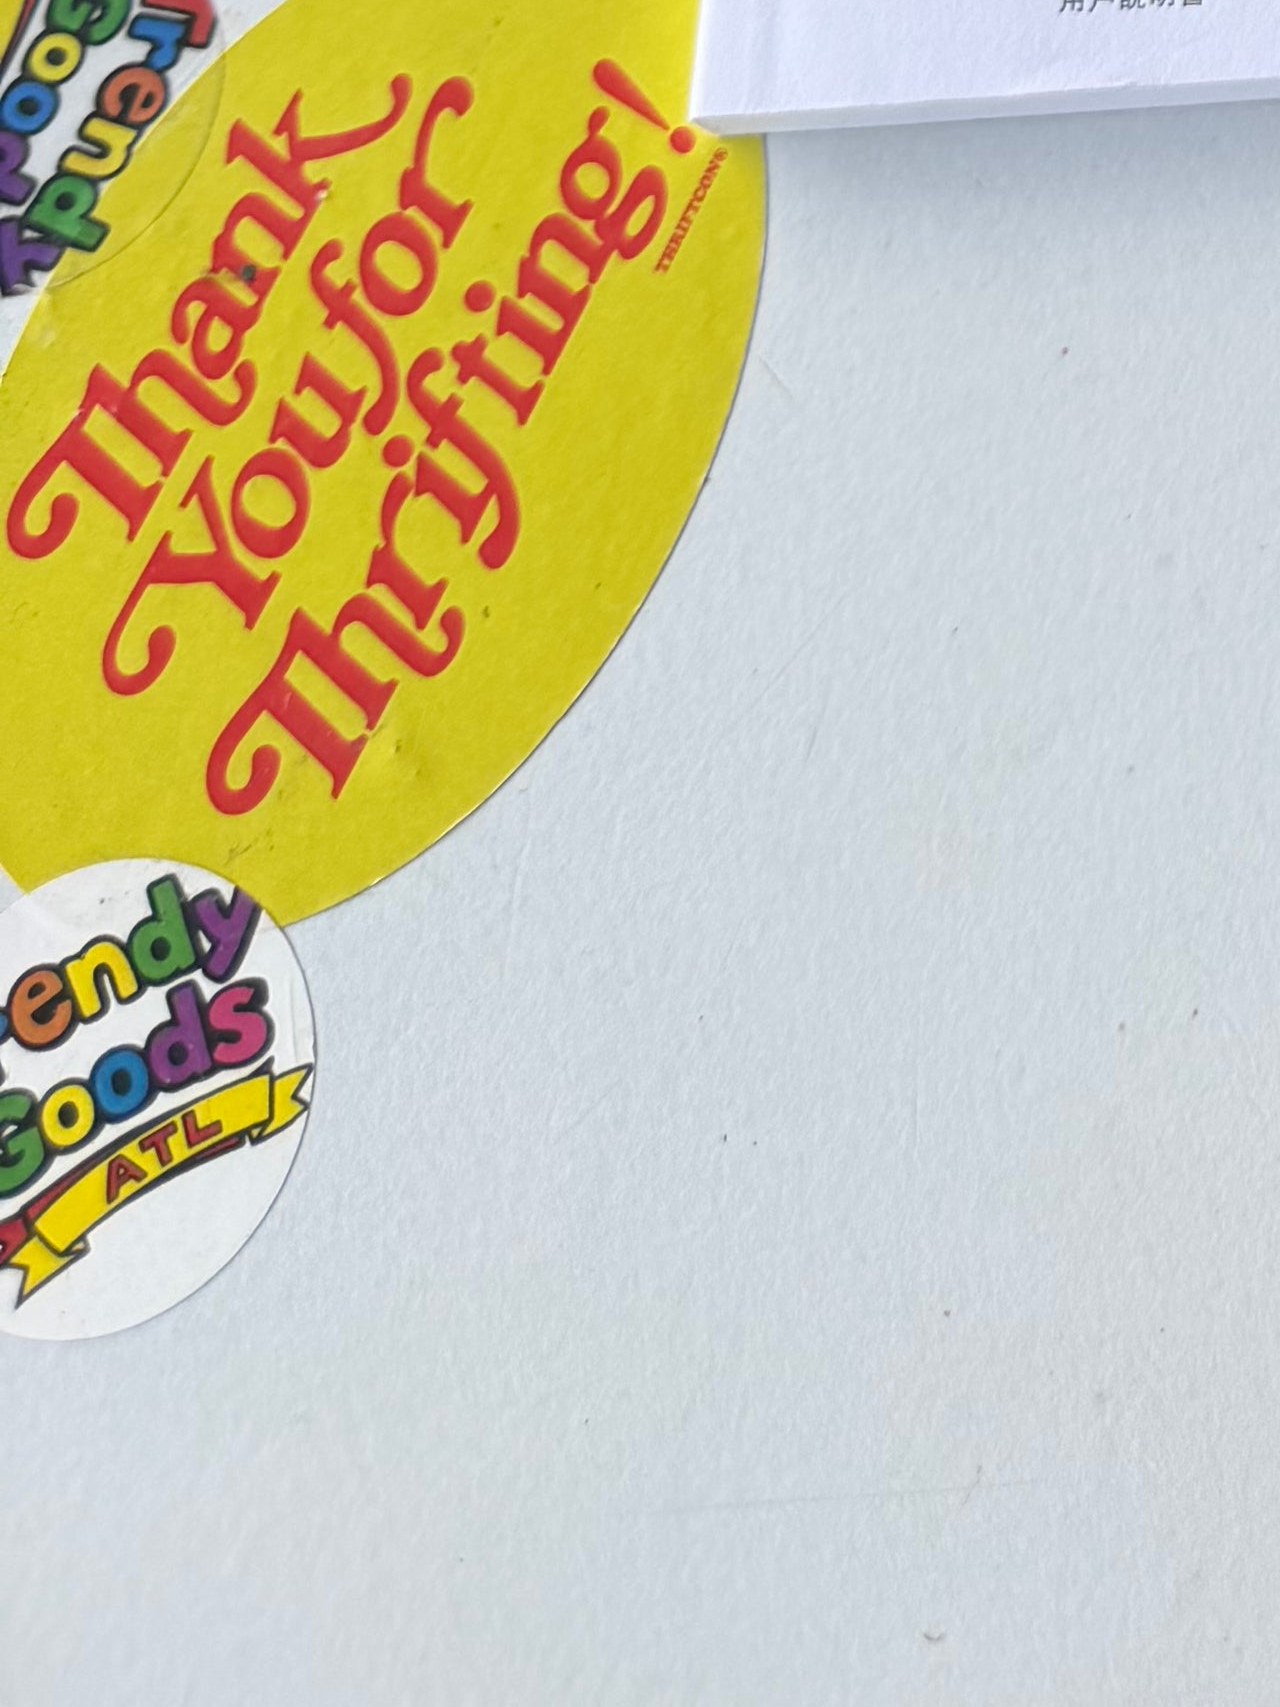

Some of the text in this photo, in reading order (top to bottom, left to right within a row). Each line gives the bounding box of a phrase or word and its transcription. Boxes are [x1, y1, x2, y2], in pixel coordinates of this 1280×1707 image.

[4, 70, 416, 561] Thank
[204, 56, 699, 819] Thrifting!
[104, 1118, 223, 1204] ATL
